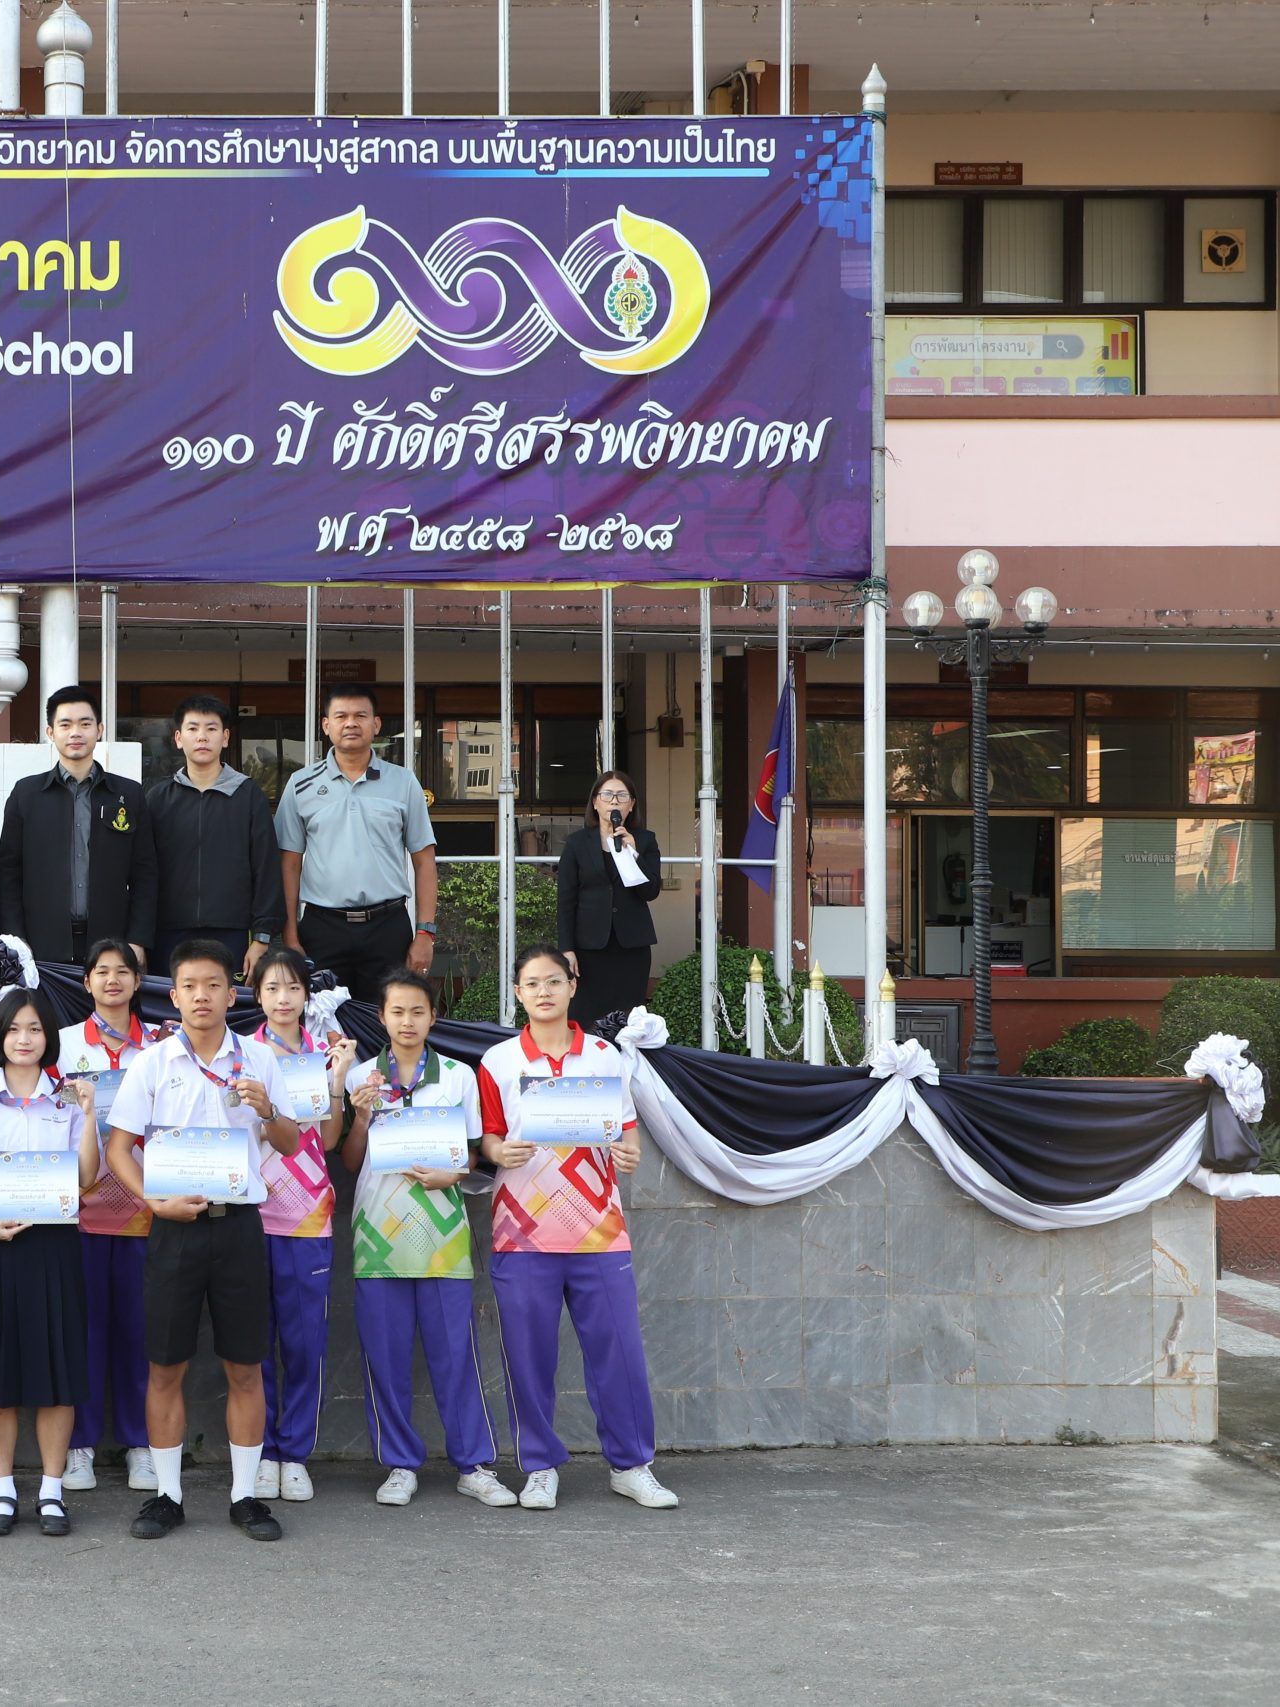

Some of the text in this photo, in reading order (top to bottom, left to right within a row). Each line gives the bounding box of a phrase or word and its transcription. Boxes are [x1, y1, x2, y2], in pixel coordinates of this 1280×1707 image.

[126, 126, 439, 176] จัดการศึกษามุ่งสู่สากล
[448, 120, 777, 173] บนพื้นฐานความเป็นไทย
[162, 383, 832, 471] ๑๑๐ ปี ศักดิ์ศรีสรรพวิทยาคม
